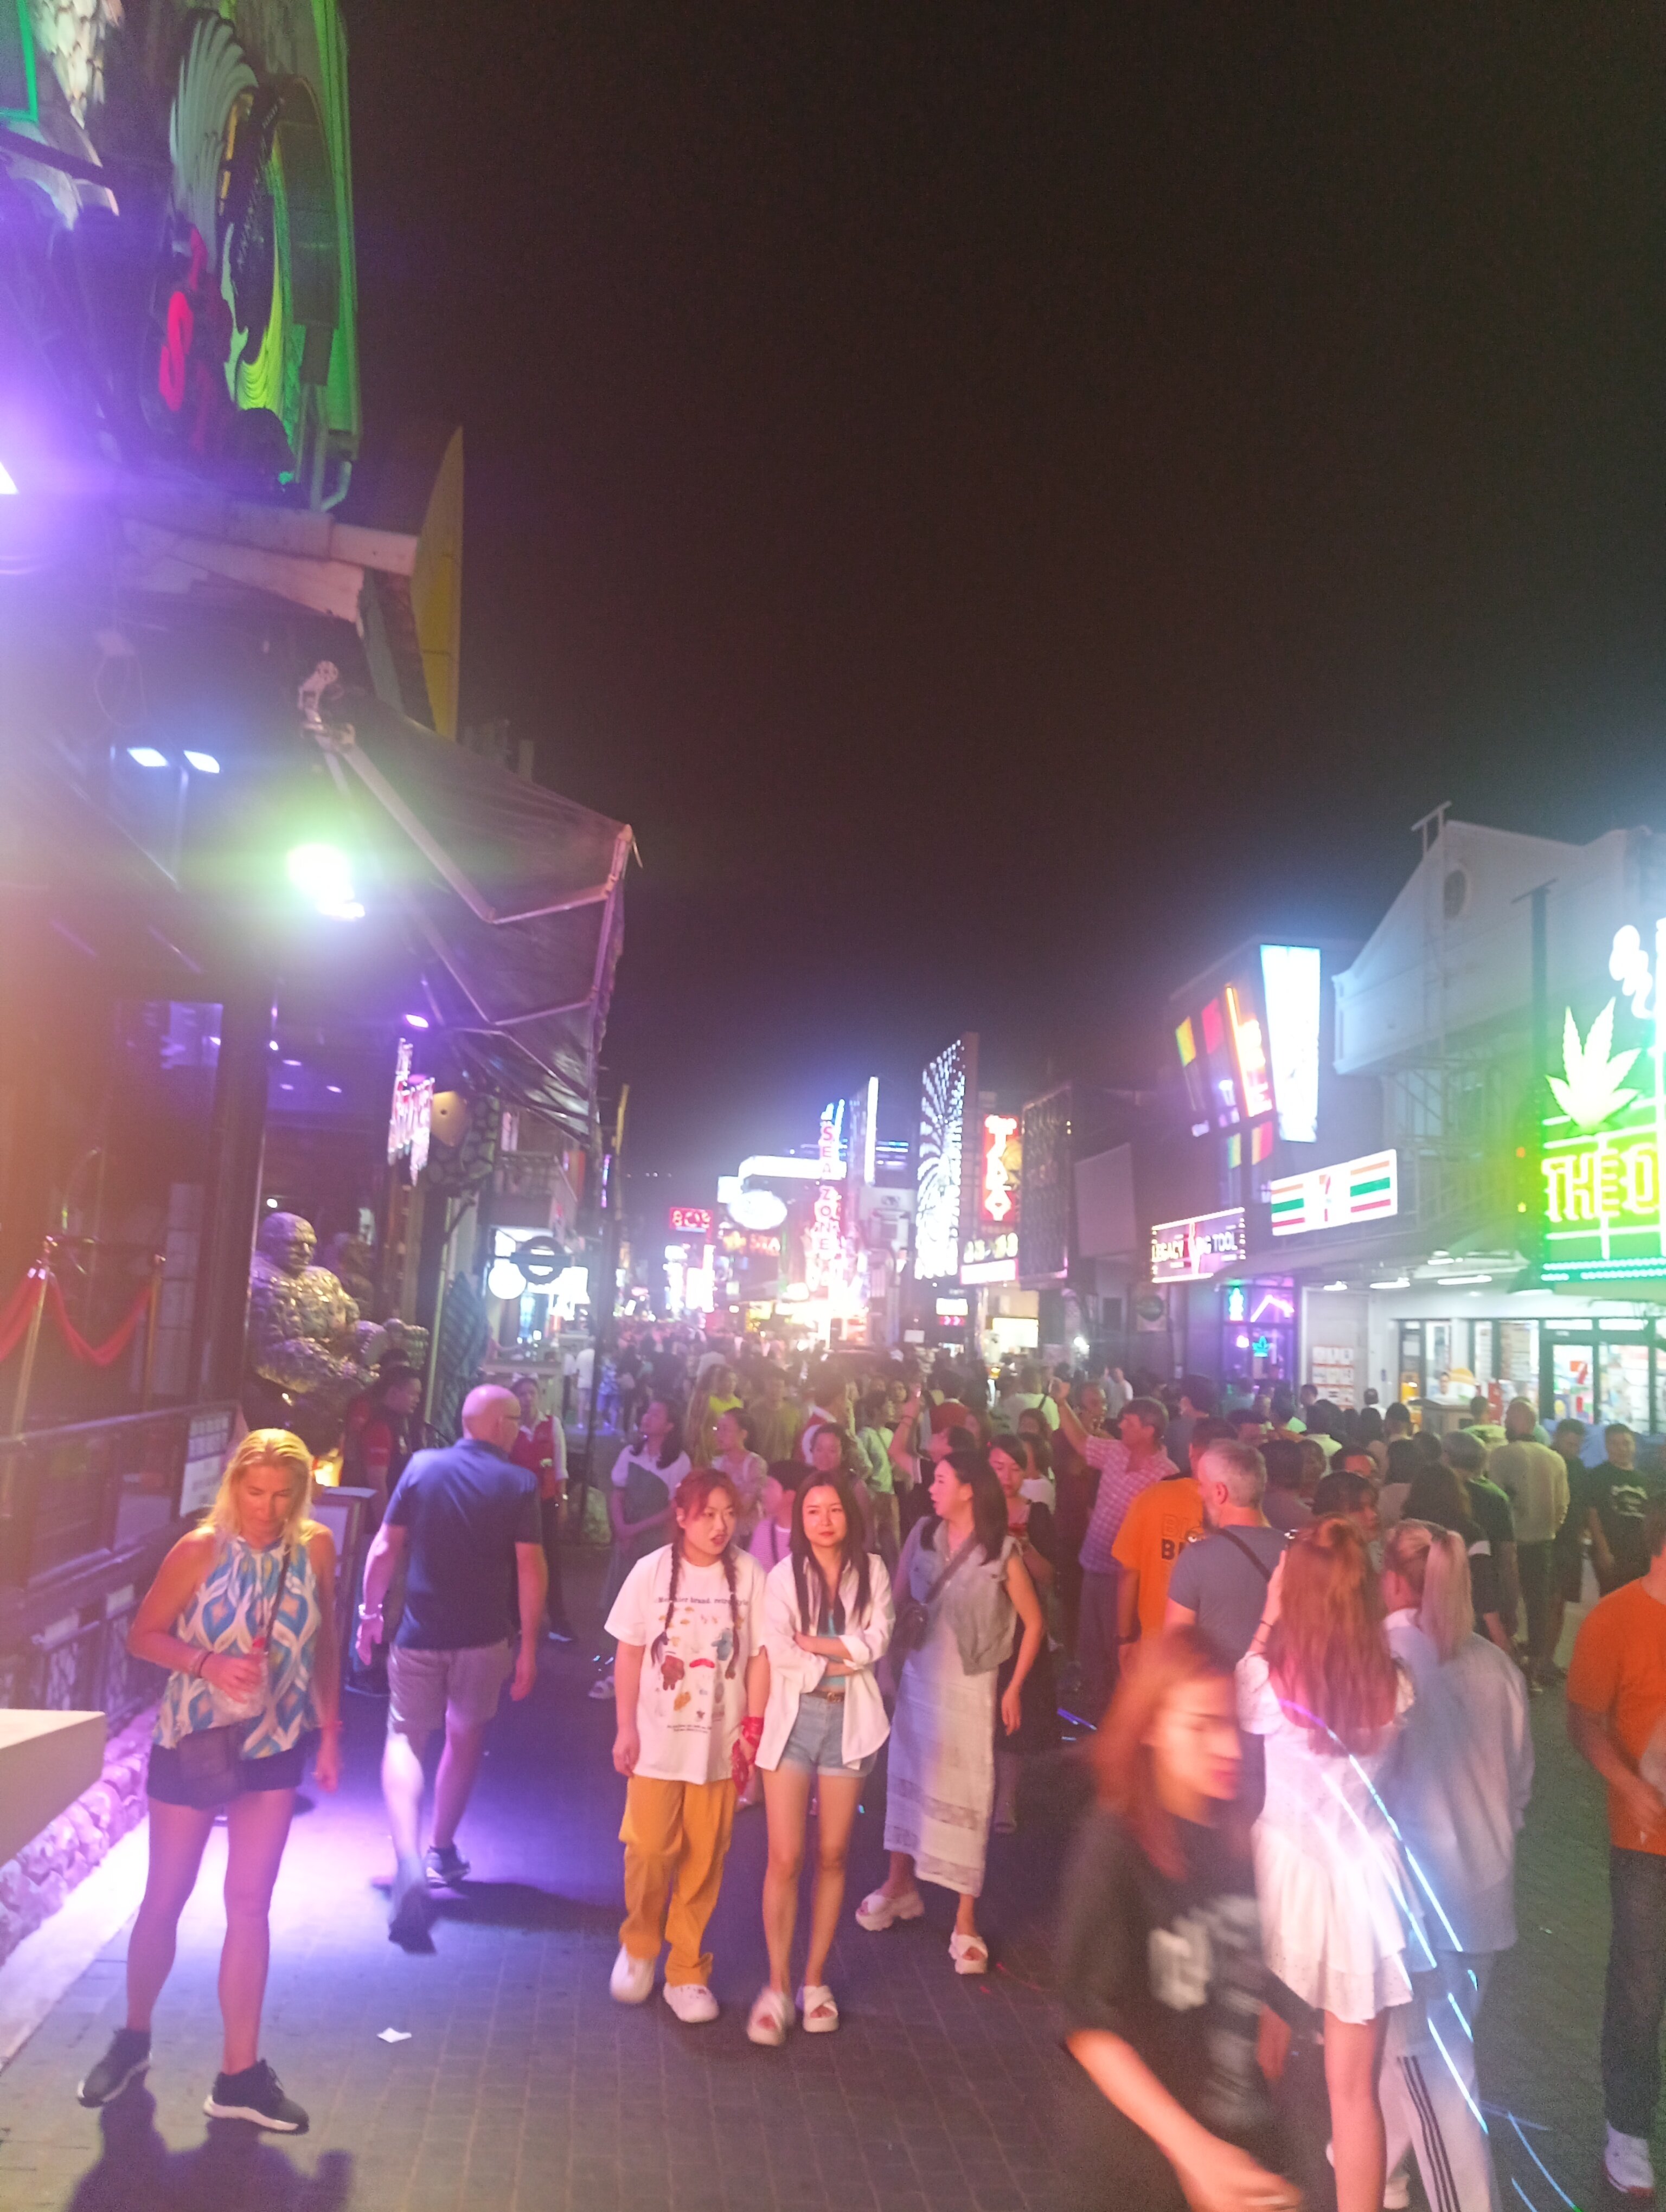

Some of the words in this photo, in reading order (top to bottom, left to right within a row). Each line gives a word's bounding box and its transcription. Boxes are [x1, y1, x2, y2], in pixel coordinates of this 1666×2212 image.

[821, 1126, 834, 1174] SEA
[1541, 1148, 1620, 1223] THE
[819, 1188, 832, 1250] ZONE
[1151, 1240, 1184, 1263] LEGACY
[1213, 1232, 1238, 1252] TOOL
